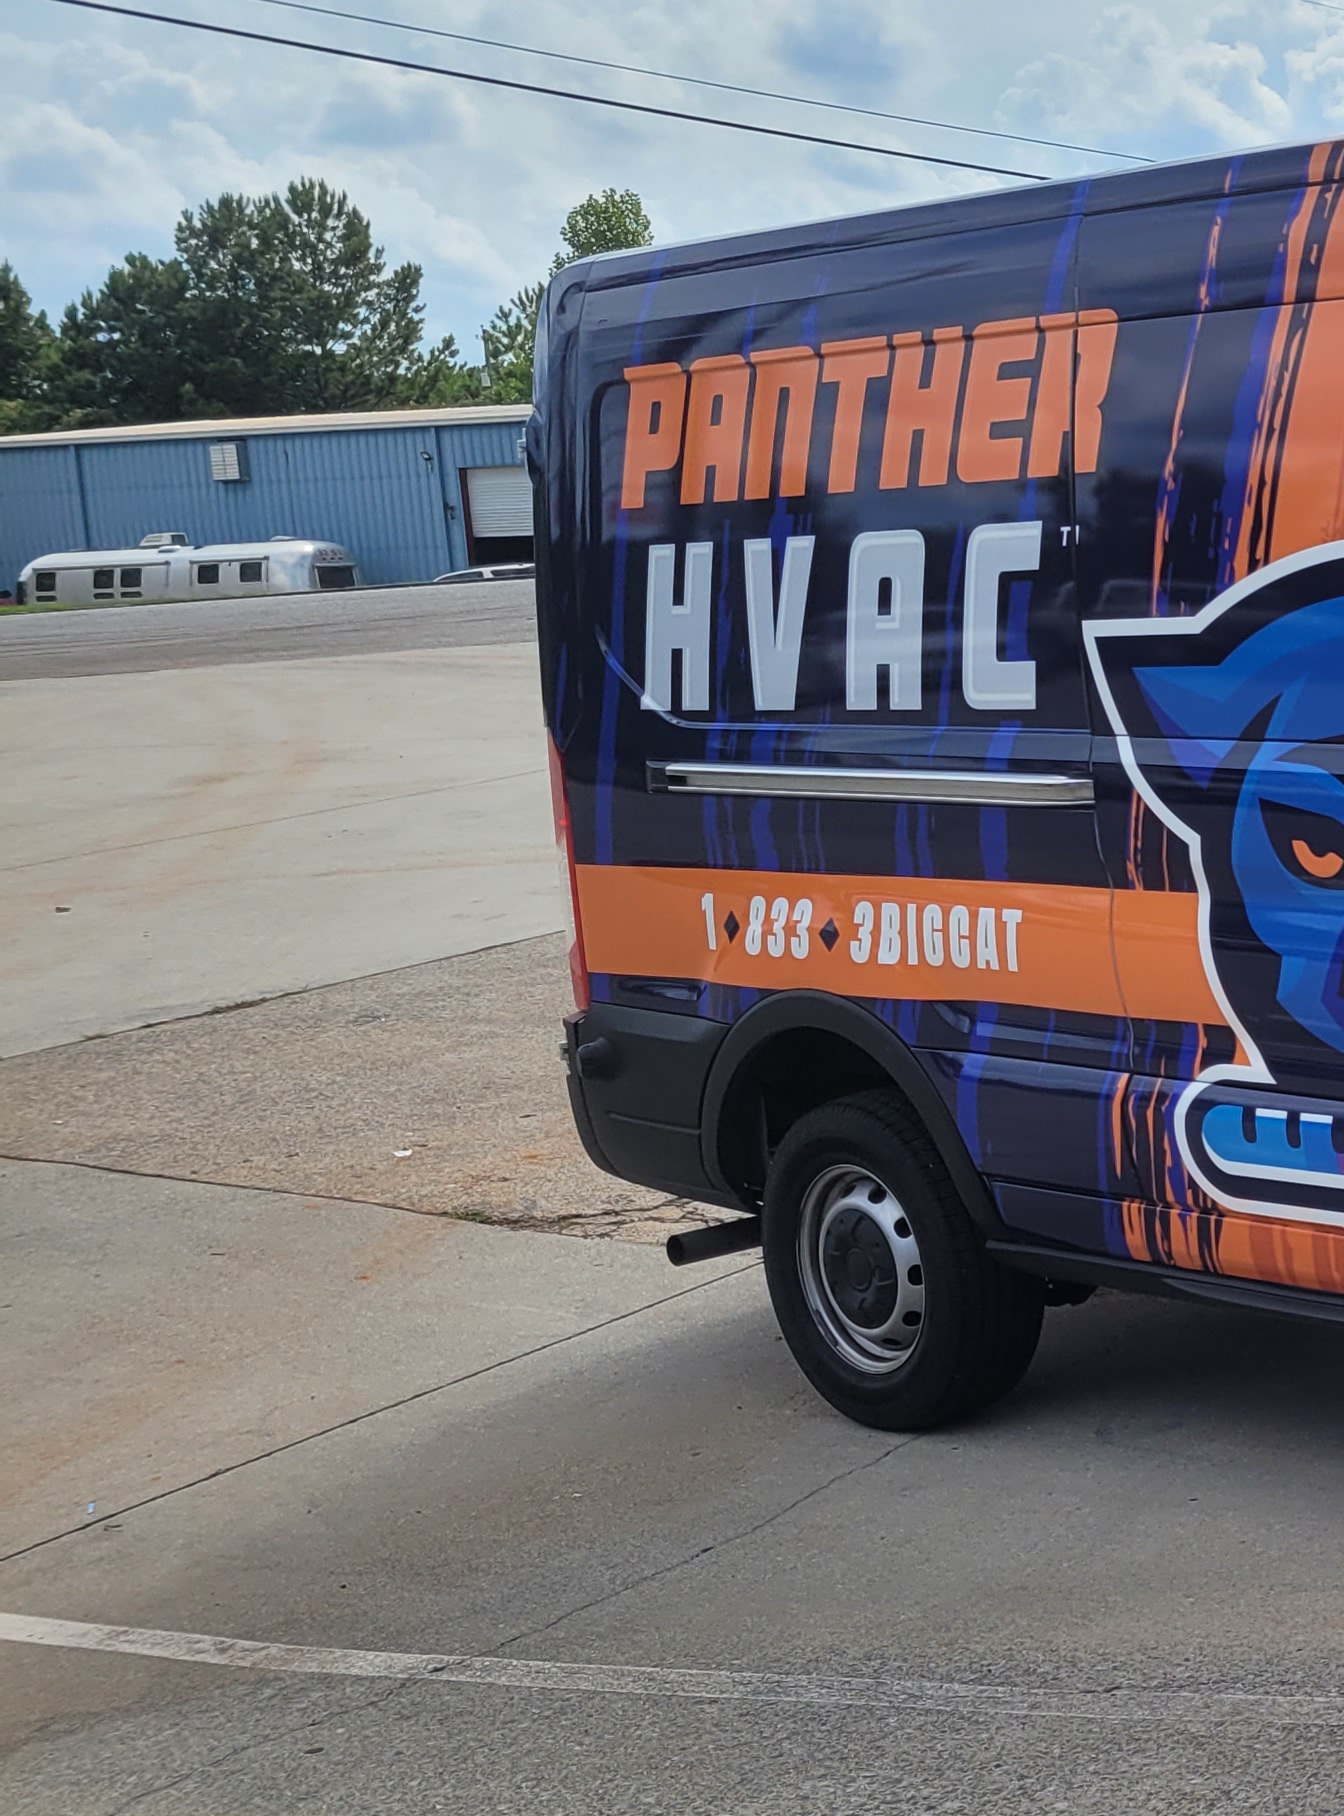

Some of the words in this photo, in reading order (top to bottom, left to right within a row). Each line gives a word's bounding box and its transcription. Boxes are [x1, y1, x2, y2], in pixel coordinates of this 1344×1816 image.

[622, 308, 1119, 509] PANTHER
[640, 520, 1043, 711] HVAC
[701, 892, 717, 950] 1
[744, 895, 813, 960] 833
[850, 900, 1023, 972] 3BIGCAT
